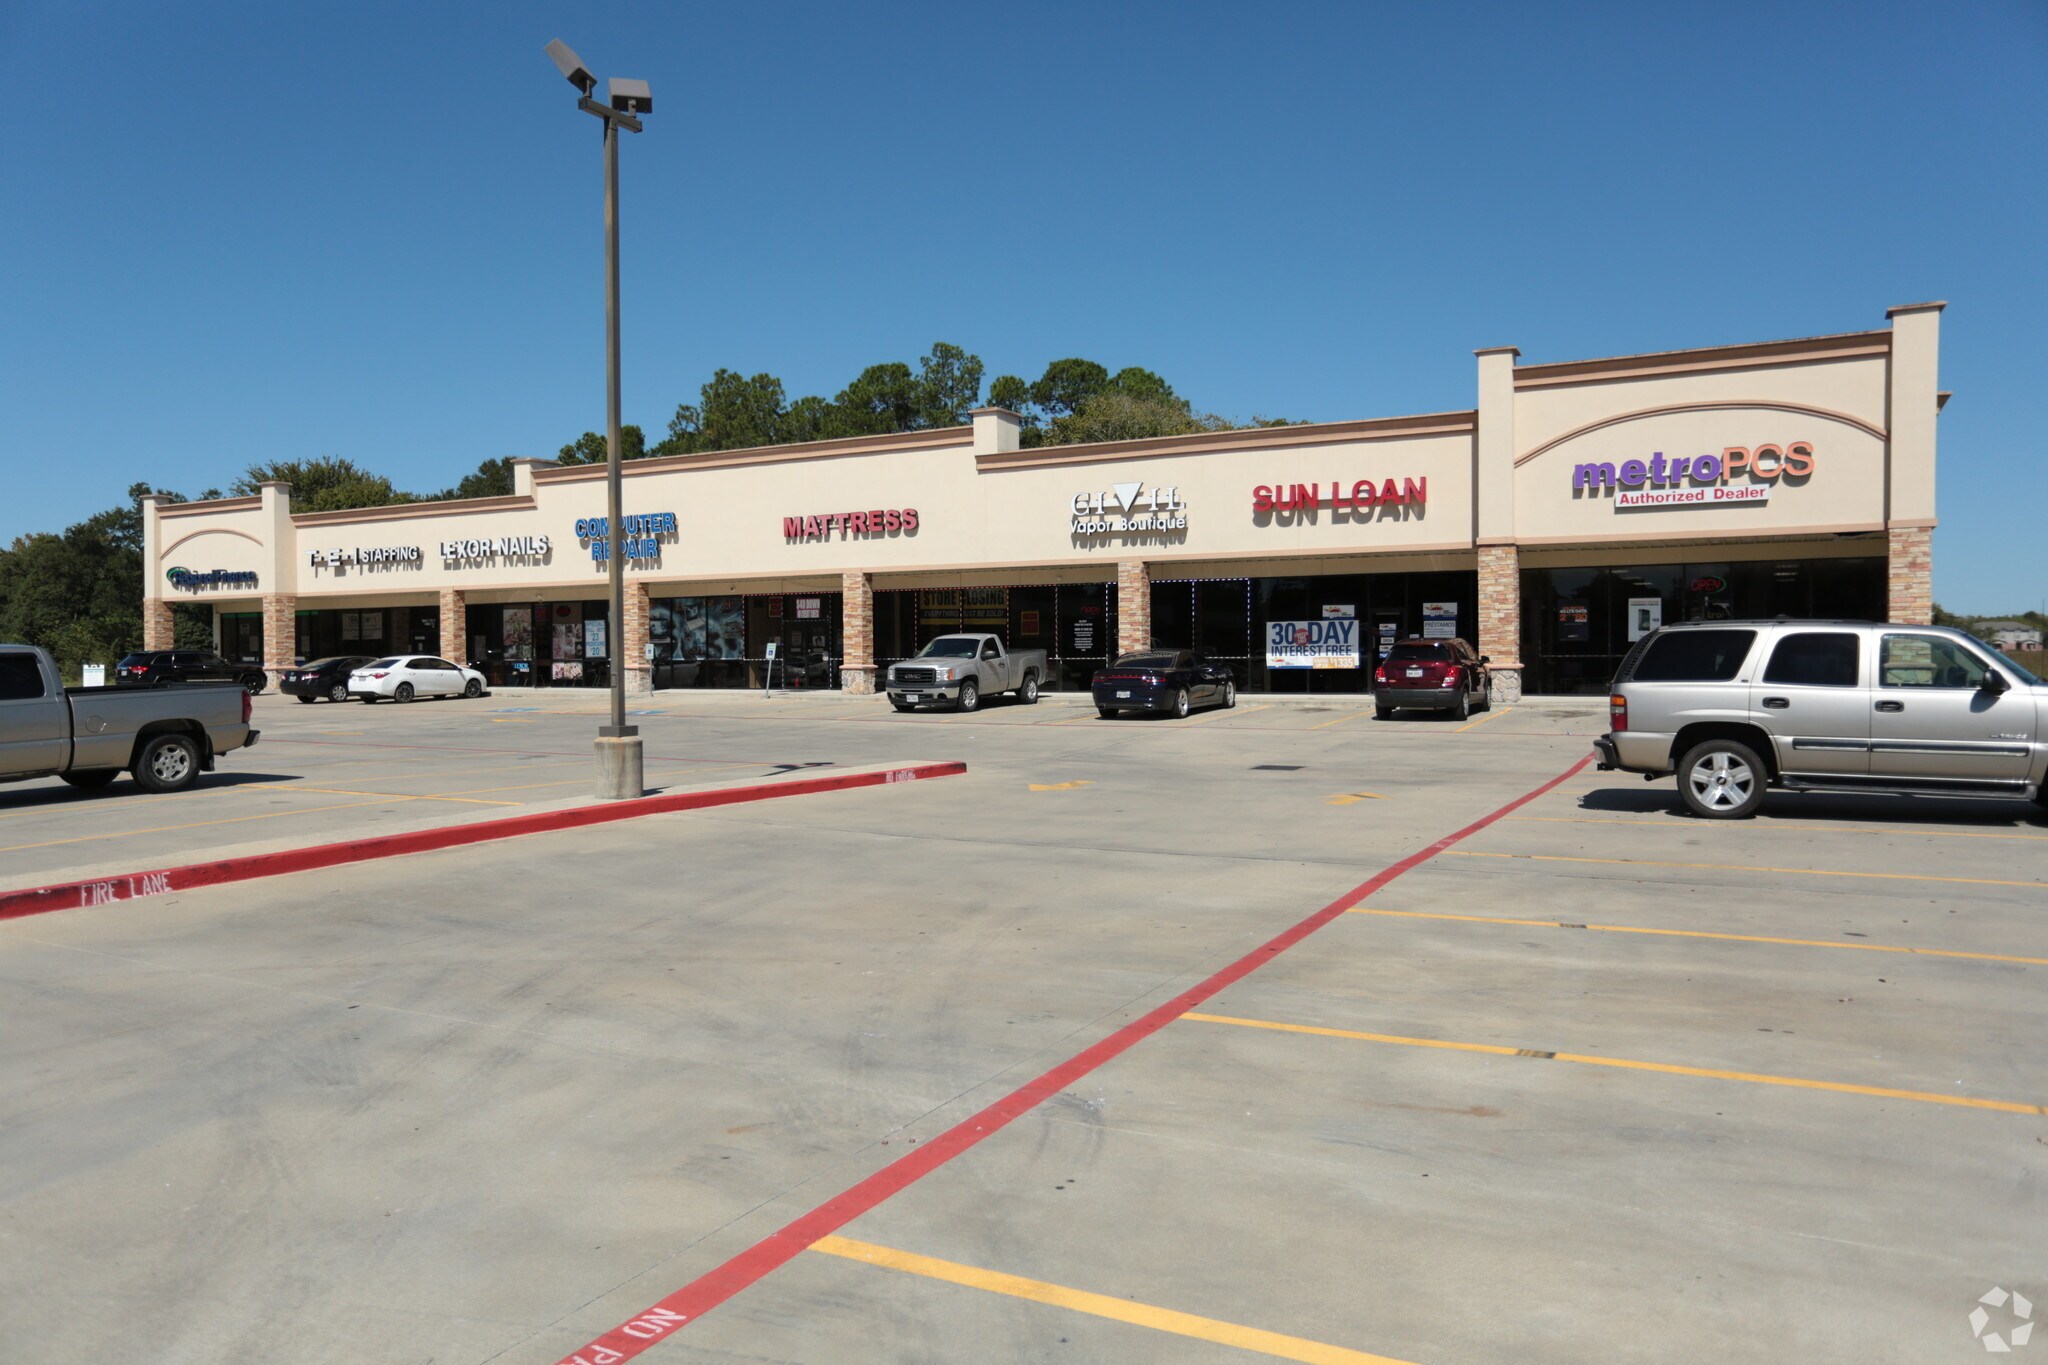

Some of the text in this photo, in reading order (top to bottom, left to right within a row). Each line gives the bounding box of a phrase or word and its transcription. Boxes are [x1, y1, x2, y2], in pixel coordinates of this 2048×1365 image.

[1574, 441, 1815, 489] metroPCS
[1253, 476, 1427, 512] SUN LOAN
[1619, 486, 1767, 506] Authorized Dealer
[784, 508, 919, 538] MATTRESS
[1070, 516, 1186, 535] Vapor Boutique
[362, 546, 419, 563] STAFFING
[439, 535, 549, 560] LEXOR NAILS
[924, 590, 956, 606] STORE
[1271, 622, 1296, 646] 30
[1307, 621, 1354, 645] DAY
[1271, 644, 1352, 657] INTEREST FREE
[81, 871, 174, 907] FIRE LANE
[622, 1307, 687, 1339] NO
